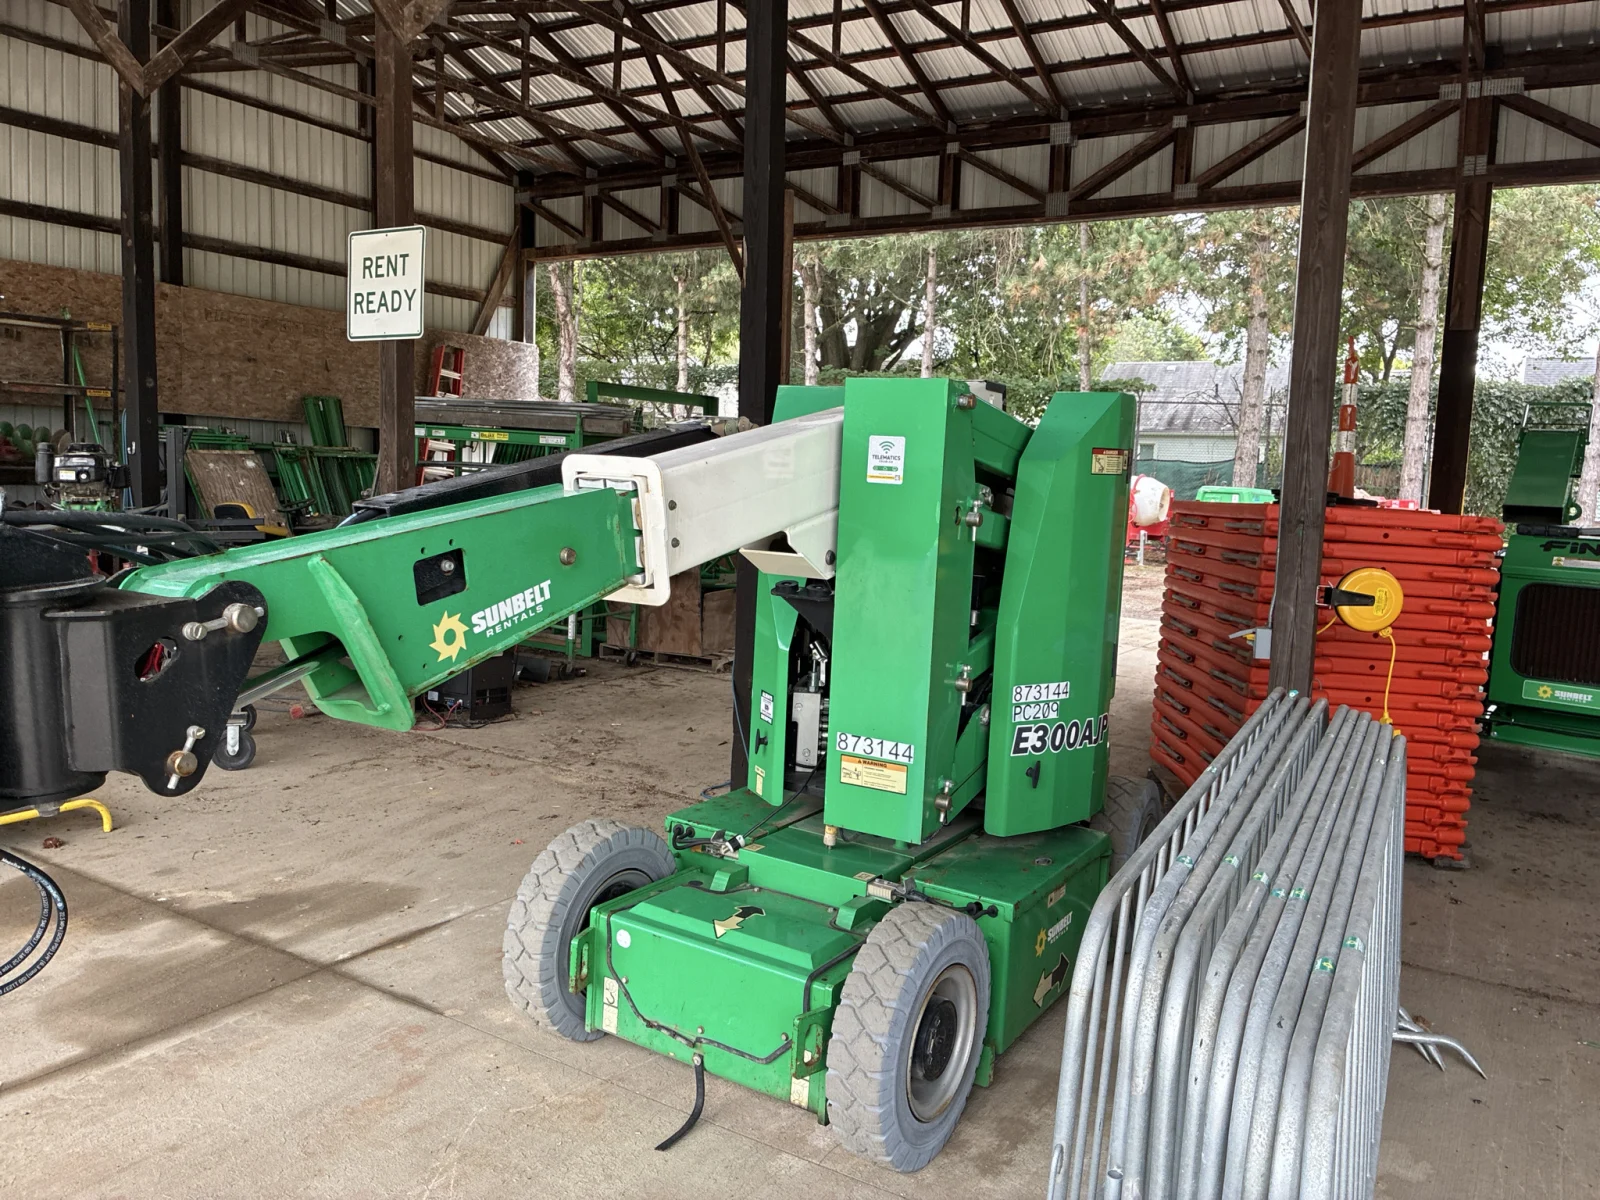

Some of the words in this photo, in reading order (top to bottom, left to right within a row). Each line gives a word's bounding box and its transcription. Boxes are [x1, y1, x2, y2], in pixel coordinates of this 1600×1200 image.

[362, 253, 409, 279] RENT
[354, 288, 417, 315] READY
[471, 579, 551, 634] SUNBELT
[486, 604, 543, 638] RENTALS
[1013, 682, 1069, 703] 873144
[1554, 690, 1592, 701] SUNBELT
[1013, 701, 1059, 722] PC209
[837, 732, 913, 762] 873144
[1010, 713, 1108, 756] E300AJP
[862, 760, 888, 768] WARNING
[1047, 910, 1073, 942] SUNBELT
